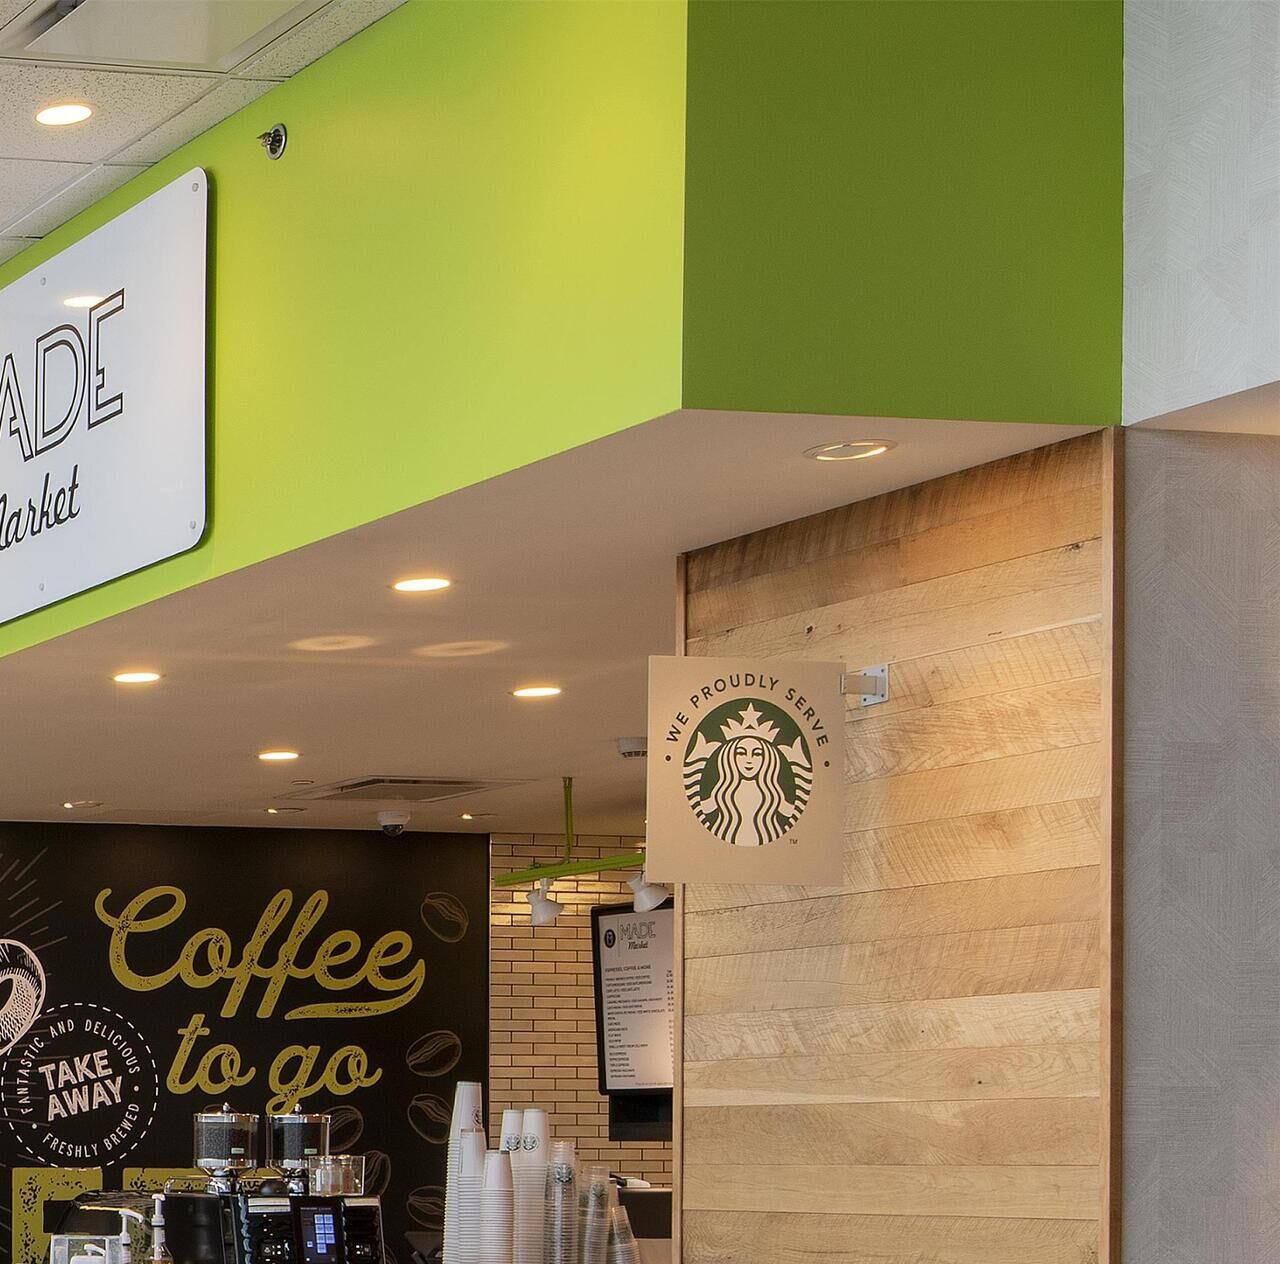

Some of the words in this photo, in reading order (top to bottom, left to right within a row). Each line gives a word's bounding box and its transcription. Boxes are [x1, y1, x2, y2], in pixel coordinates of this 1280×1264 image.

[666, 711, 689, 743] WE
[690, 673, 780, 709] PROUDLY
[785, 687, 829, 748] SERVE
[94, 885, 426, 1020] Coffee
[16, 1037, 45, 1115] FANTASTIC
[49, 1019, 75, 1038] AND
[84, 1019, 141, 1074] DELICIOUS
[37, 1049, 113, 1091] TAKE
[47, 1075, 123, 1122] AWAY
[166, 1013, 257, 1095] to
[265, 1044, 383, 1116] go
[42, 1132, 100, 1158] FRESHLY
[103, 1103, 140, 1151] BREWED
